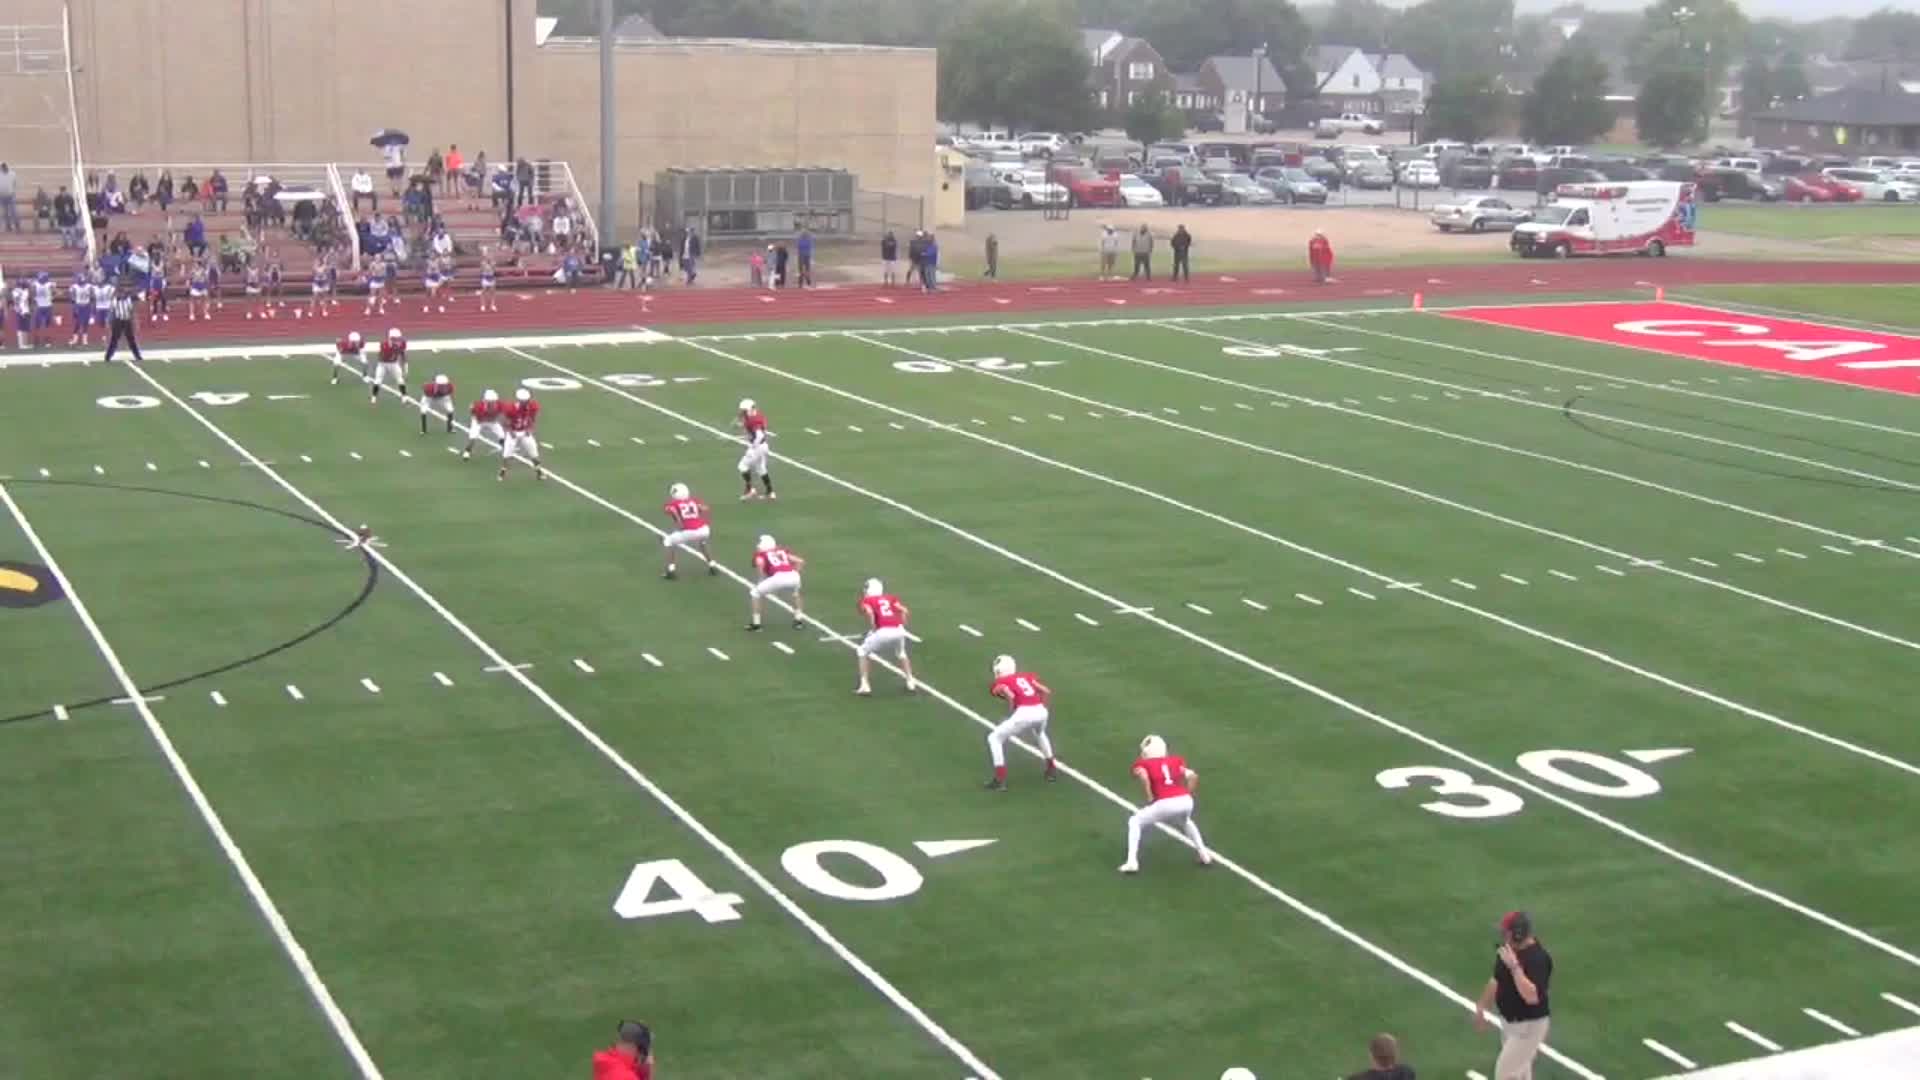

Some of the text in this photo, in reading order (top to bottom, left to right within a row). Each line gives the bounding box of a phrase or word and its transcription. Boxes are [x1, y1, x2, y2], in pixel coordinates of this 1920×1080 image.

[1612, 319, 1920, 371] CA
[878, 599, 893, 617] 2
[1016, 678, 1035, 696] 9
[1161, 763, 1174, 785] 1
[1375, 749, 1662, 819] 30
[613, 840, 924, 923] 40
